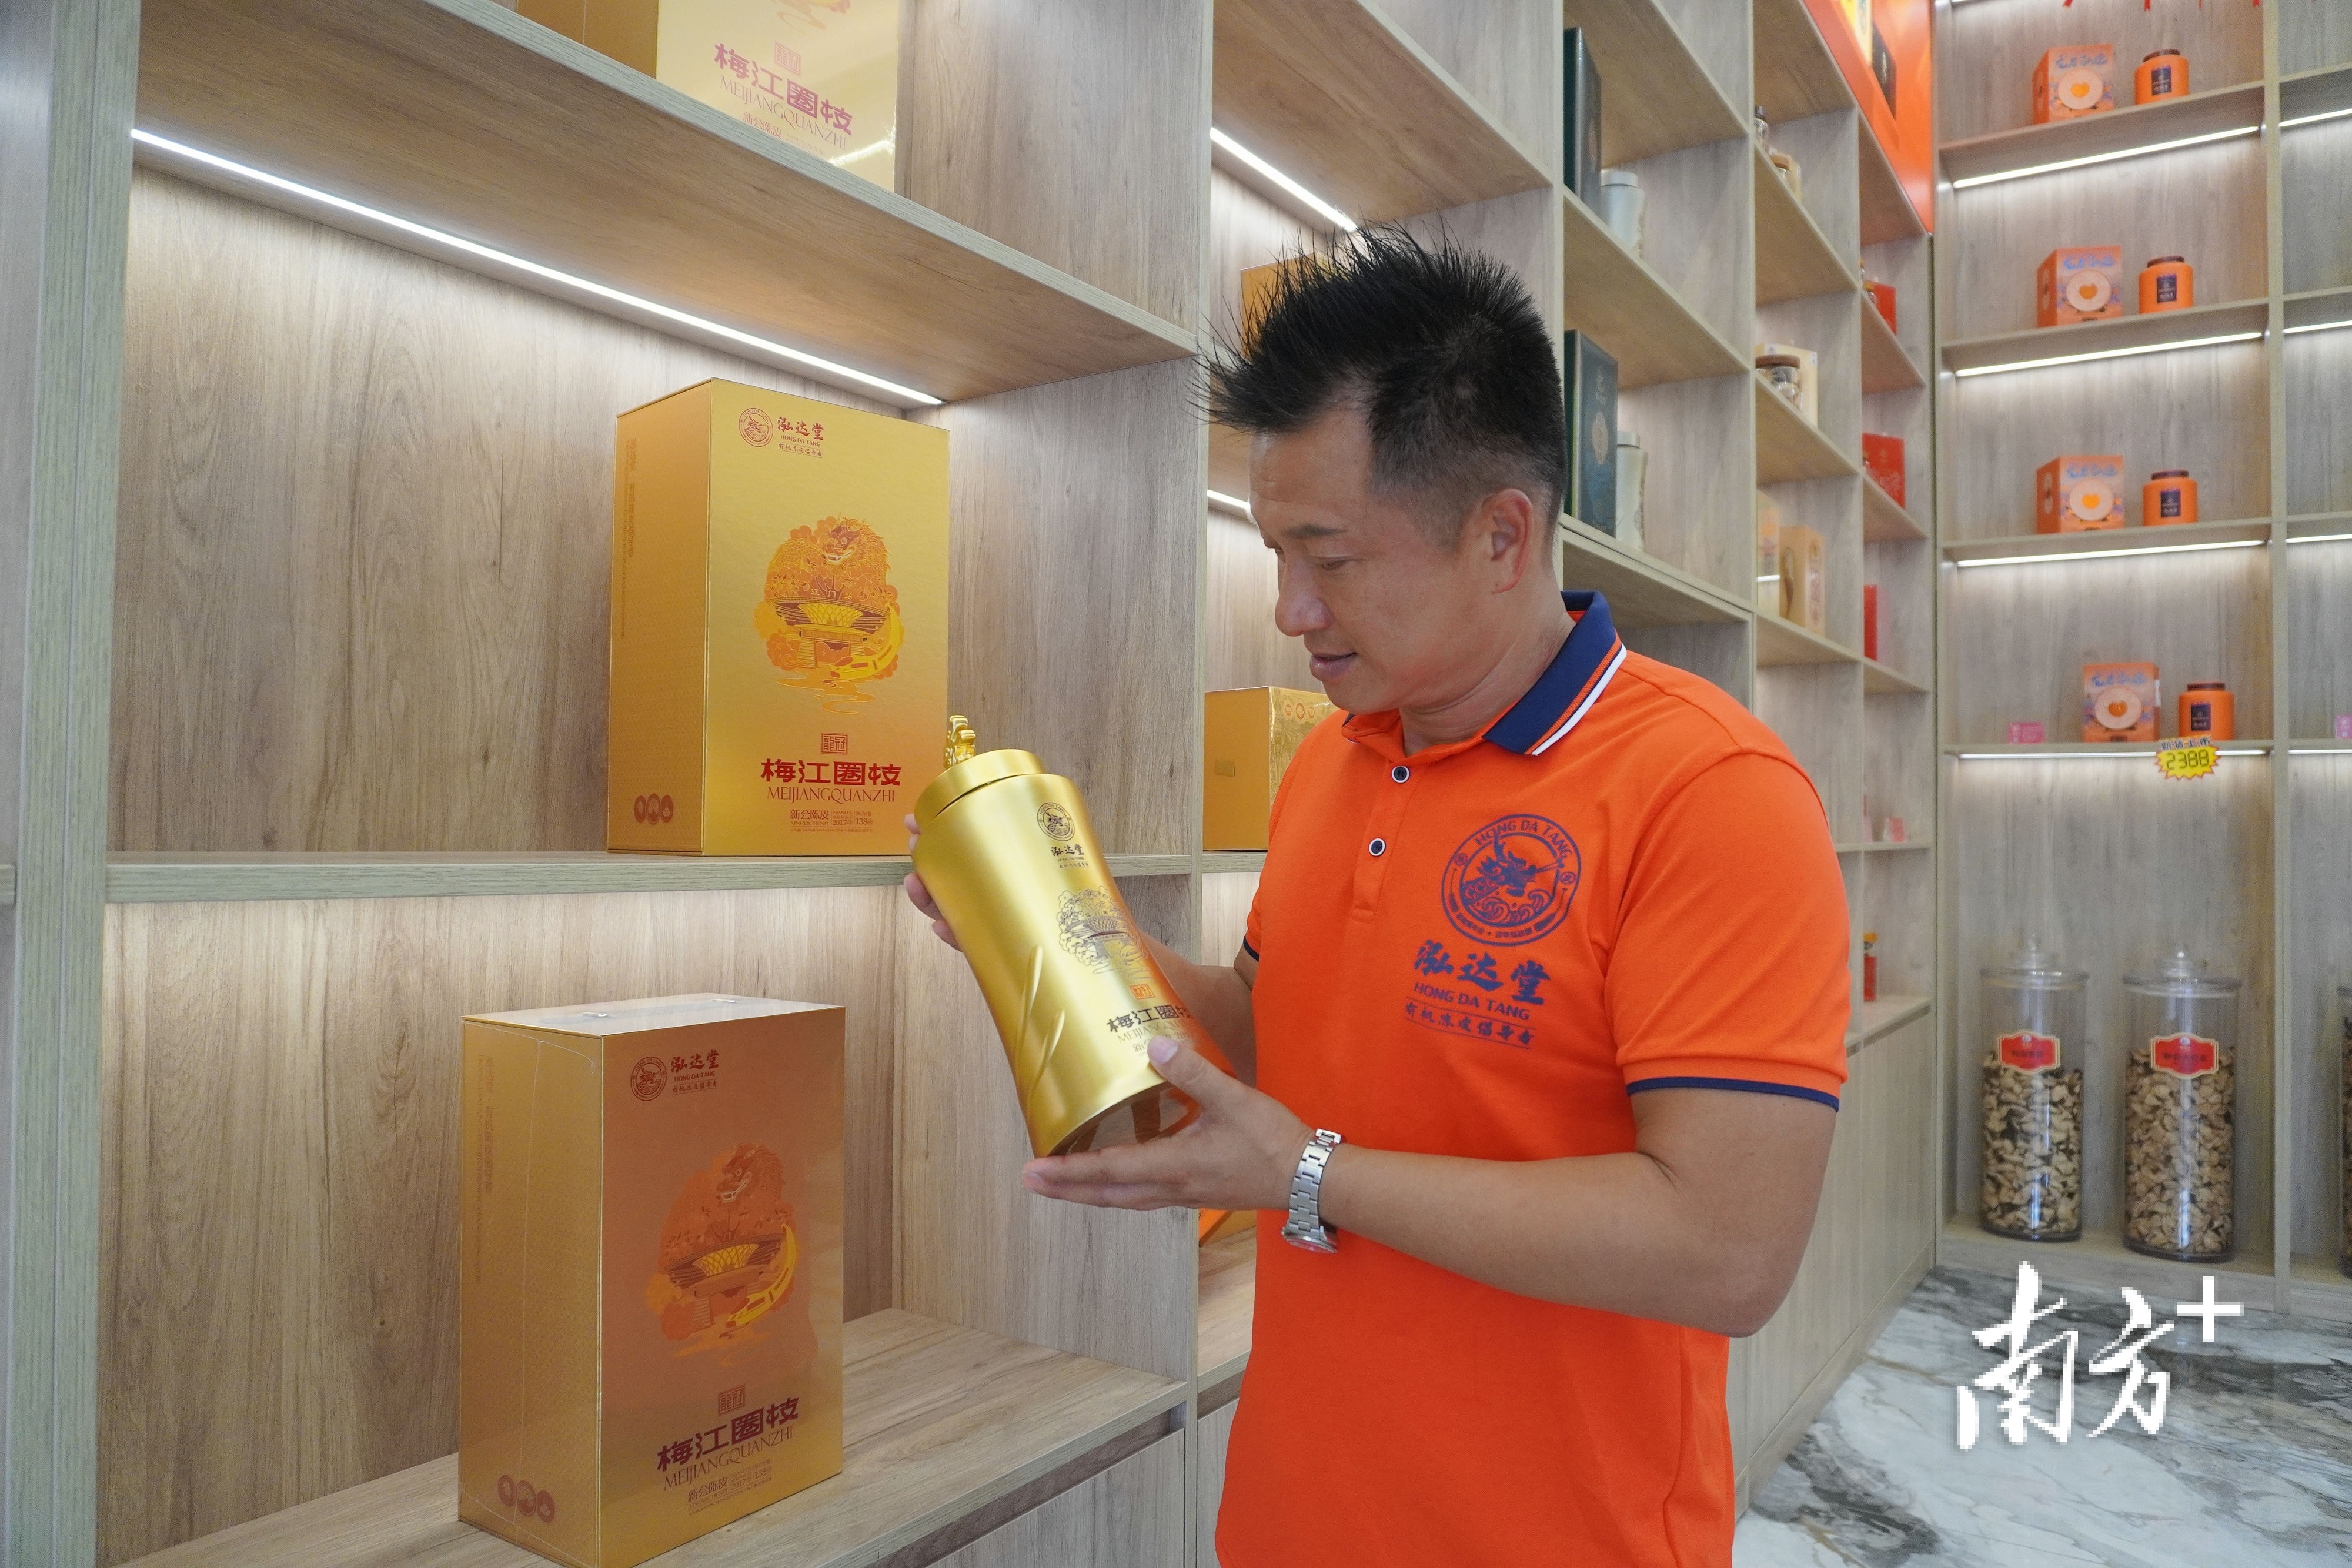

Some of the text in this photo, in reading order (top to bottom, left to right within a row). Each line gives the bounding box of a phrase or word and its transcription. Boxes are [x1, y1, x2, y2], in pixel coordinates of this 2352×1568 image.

[720, 75, 846, 149] MEIJIANGQUANZHI
[2166, 749, 2210, 770] 2388
[767, 786, 895, 804] MEIJIANGQUANZHI
[790, 809, 829, 820] 新会陈皮
[1474, 820, 1573, 860] HONG DA TANG
[1414, 981, 1531, 1021] HONG DA TANG
[664, 1425, 793, 1492] MEIJIANGQUANZHI
[688, 1476, 728, 1502] 新会陈皮
